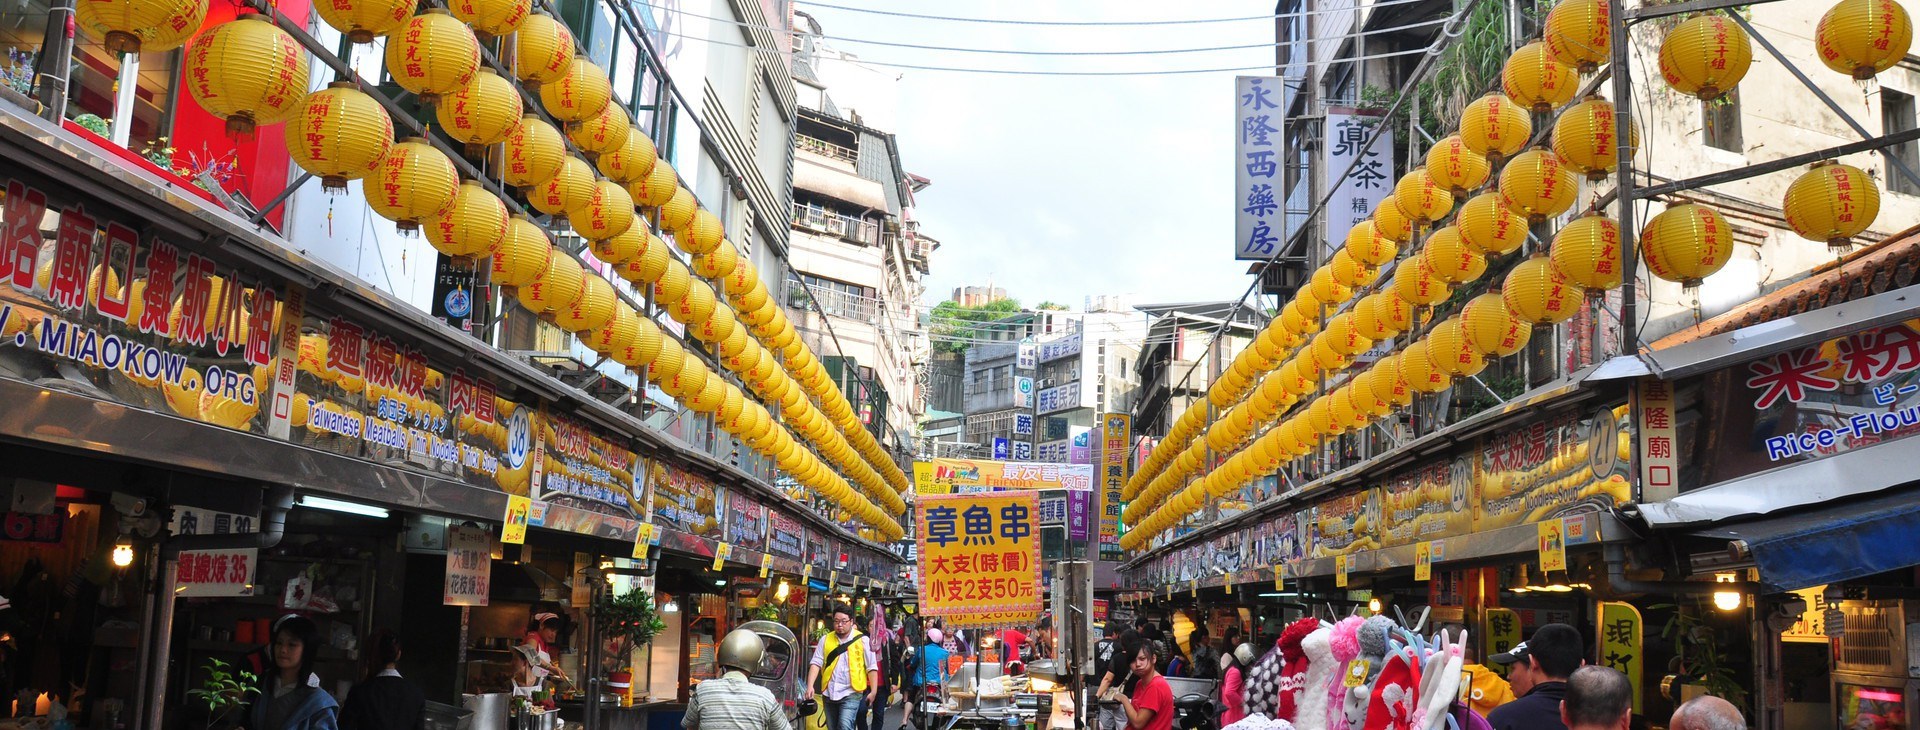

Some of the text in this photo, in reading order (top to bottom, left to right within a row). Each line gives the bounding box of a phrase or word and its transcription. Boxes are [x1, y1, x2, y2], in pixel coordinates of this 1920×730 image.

[306, 104, 328, 161] 開漳聖王
[385, 157, 405, 208] 開漳聖王
[1242, 78, 1280, 256] 永隆西藥房
[0, 305, 255, 405] .MIAOKOW.ORG
[1748, 322, 1920, 410] 米粉
[307, 400, 360, 438] Taiwanese
[429, 437, 459, 463] Noodles
[462, 444, 480, 469] Thick
[482, 452, 498, 477] Soup
[511, 417, 527, 459] 38
[1489, 421, 1547, 477] 米粉湯
[1594, 418, 1613, 466] 27
[1766, 404, 1920, 462] Rice-Flou
[1002, 463, 1090, 491] 最友善 夜市
[1453, 466, 1467, 503] 23
[1524, 489, 1555, 511] Noodles
[1558, 484, 1579, 504] Soup
[926, 503, 1031, 548] 章魚串
[230, 554, 248, 584] 35
[931, 550, 1029, 575] 大支(時價)
[930, 577, 1034, 603] 小支2支50元
